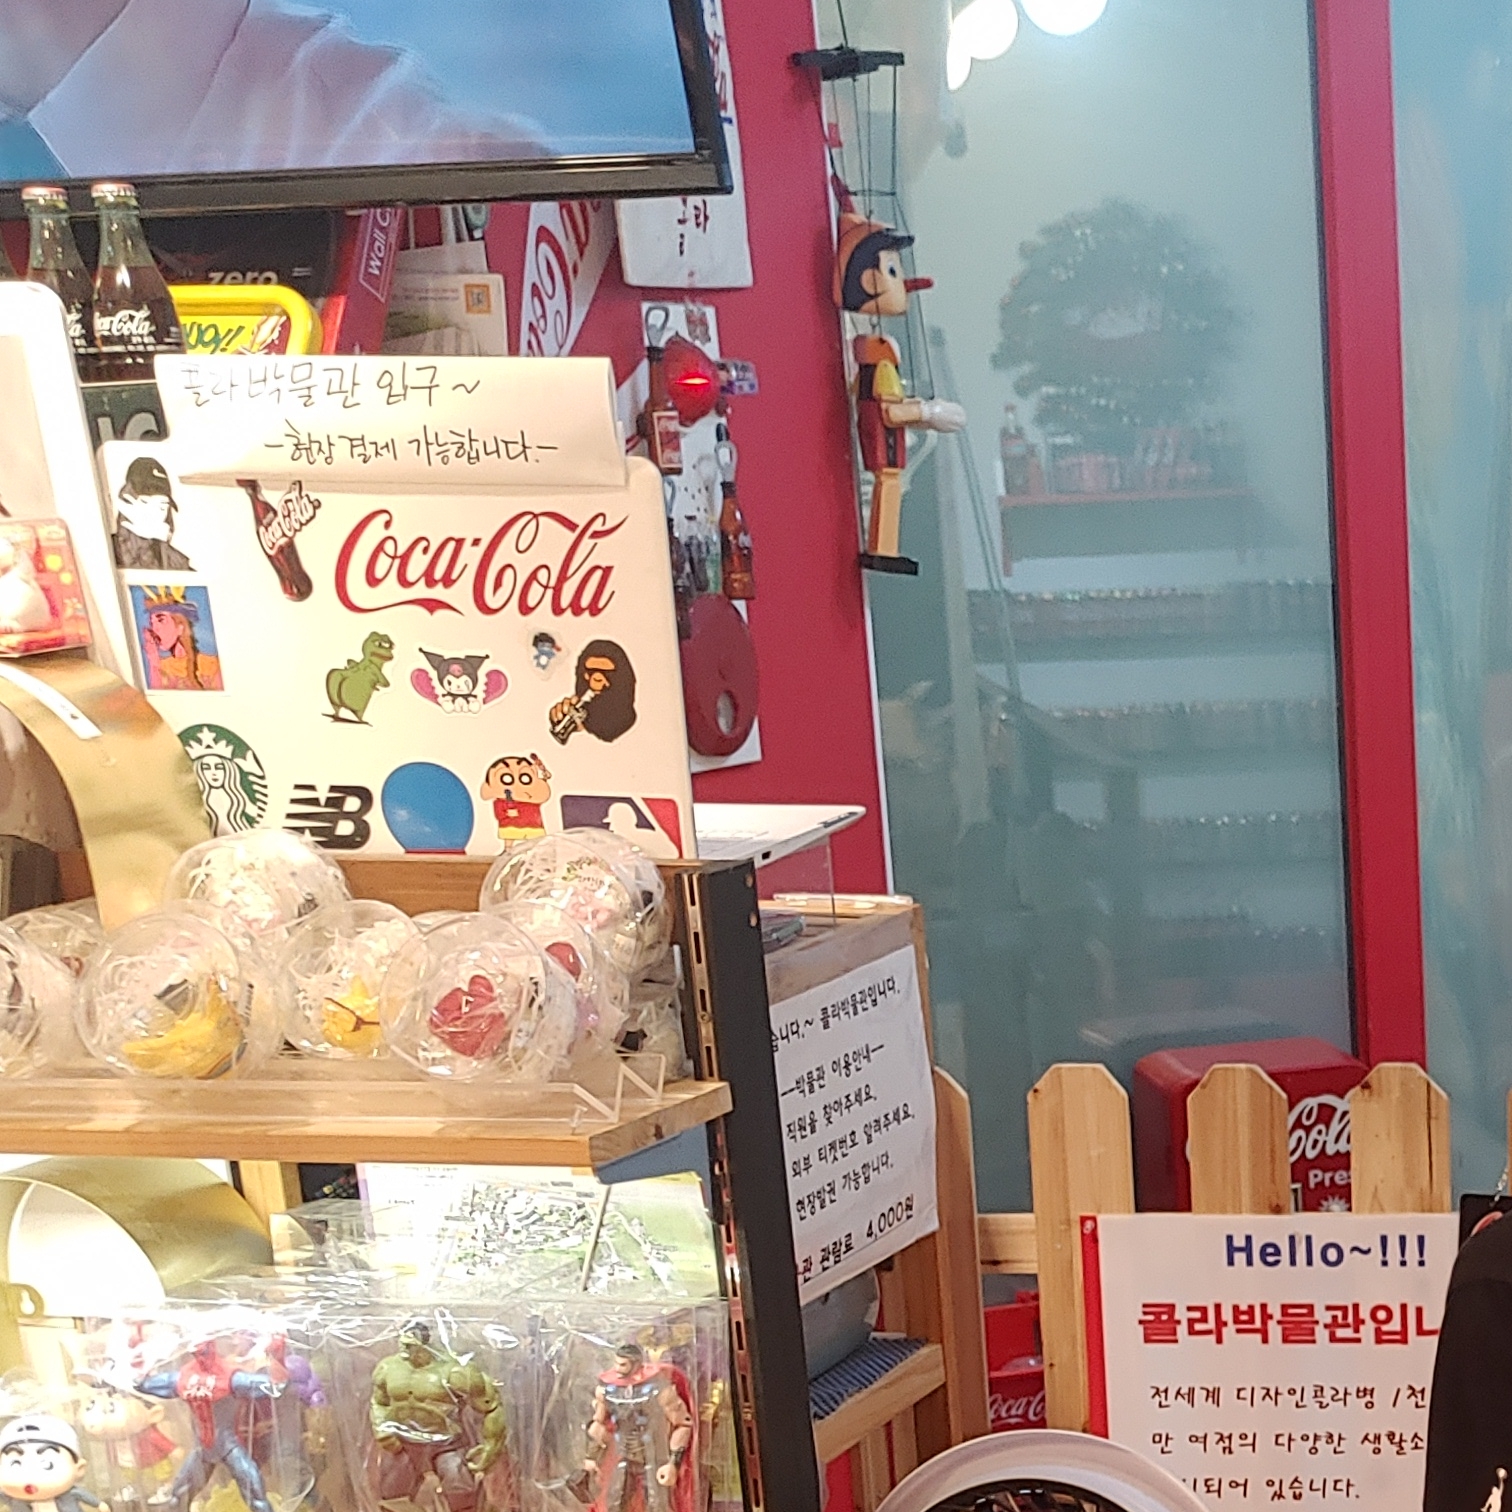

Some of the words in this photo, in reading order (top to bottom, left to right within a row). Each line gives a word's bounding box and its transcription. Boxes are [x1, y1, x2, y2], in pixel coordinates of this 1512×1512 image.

[376, 361, 440, 406] 입구
[337, 433, 397, 464] 결제
[334, 508, 630, 618] Coca-Cola
[820, 976, 901, 1030] 콜라박물관입니다.
[786, 1109, 818, 1143] 직원을
[822, 1084, 878, 1127] 찾아주세요.
[791, 1153, 813, 1178] 외부
[817, 1130, 859, 1165] 티켓번호
[863, 1102, 916, 1145] 알려주세요.
[795, 1180, 837, 1221] 현장발권
[842, 1150, 895, 1192] 가능합니다.
[866, 1193, 914, 1241] 4,000원
[1225, 1234, 1427, 1268] Hello~!!!
[1150, 1385, 1221, 1409] 전세계
[1236, 1385, 1376, 1411] 디자인콜라병
[1151, 1432, 1175, 1456] 만
[1188, 1432, 1257, 1456] 여점의
[1274, 1431, 1347, 1456] 다양한
[1264, 1475, 1360, 1502] 있습니다.
